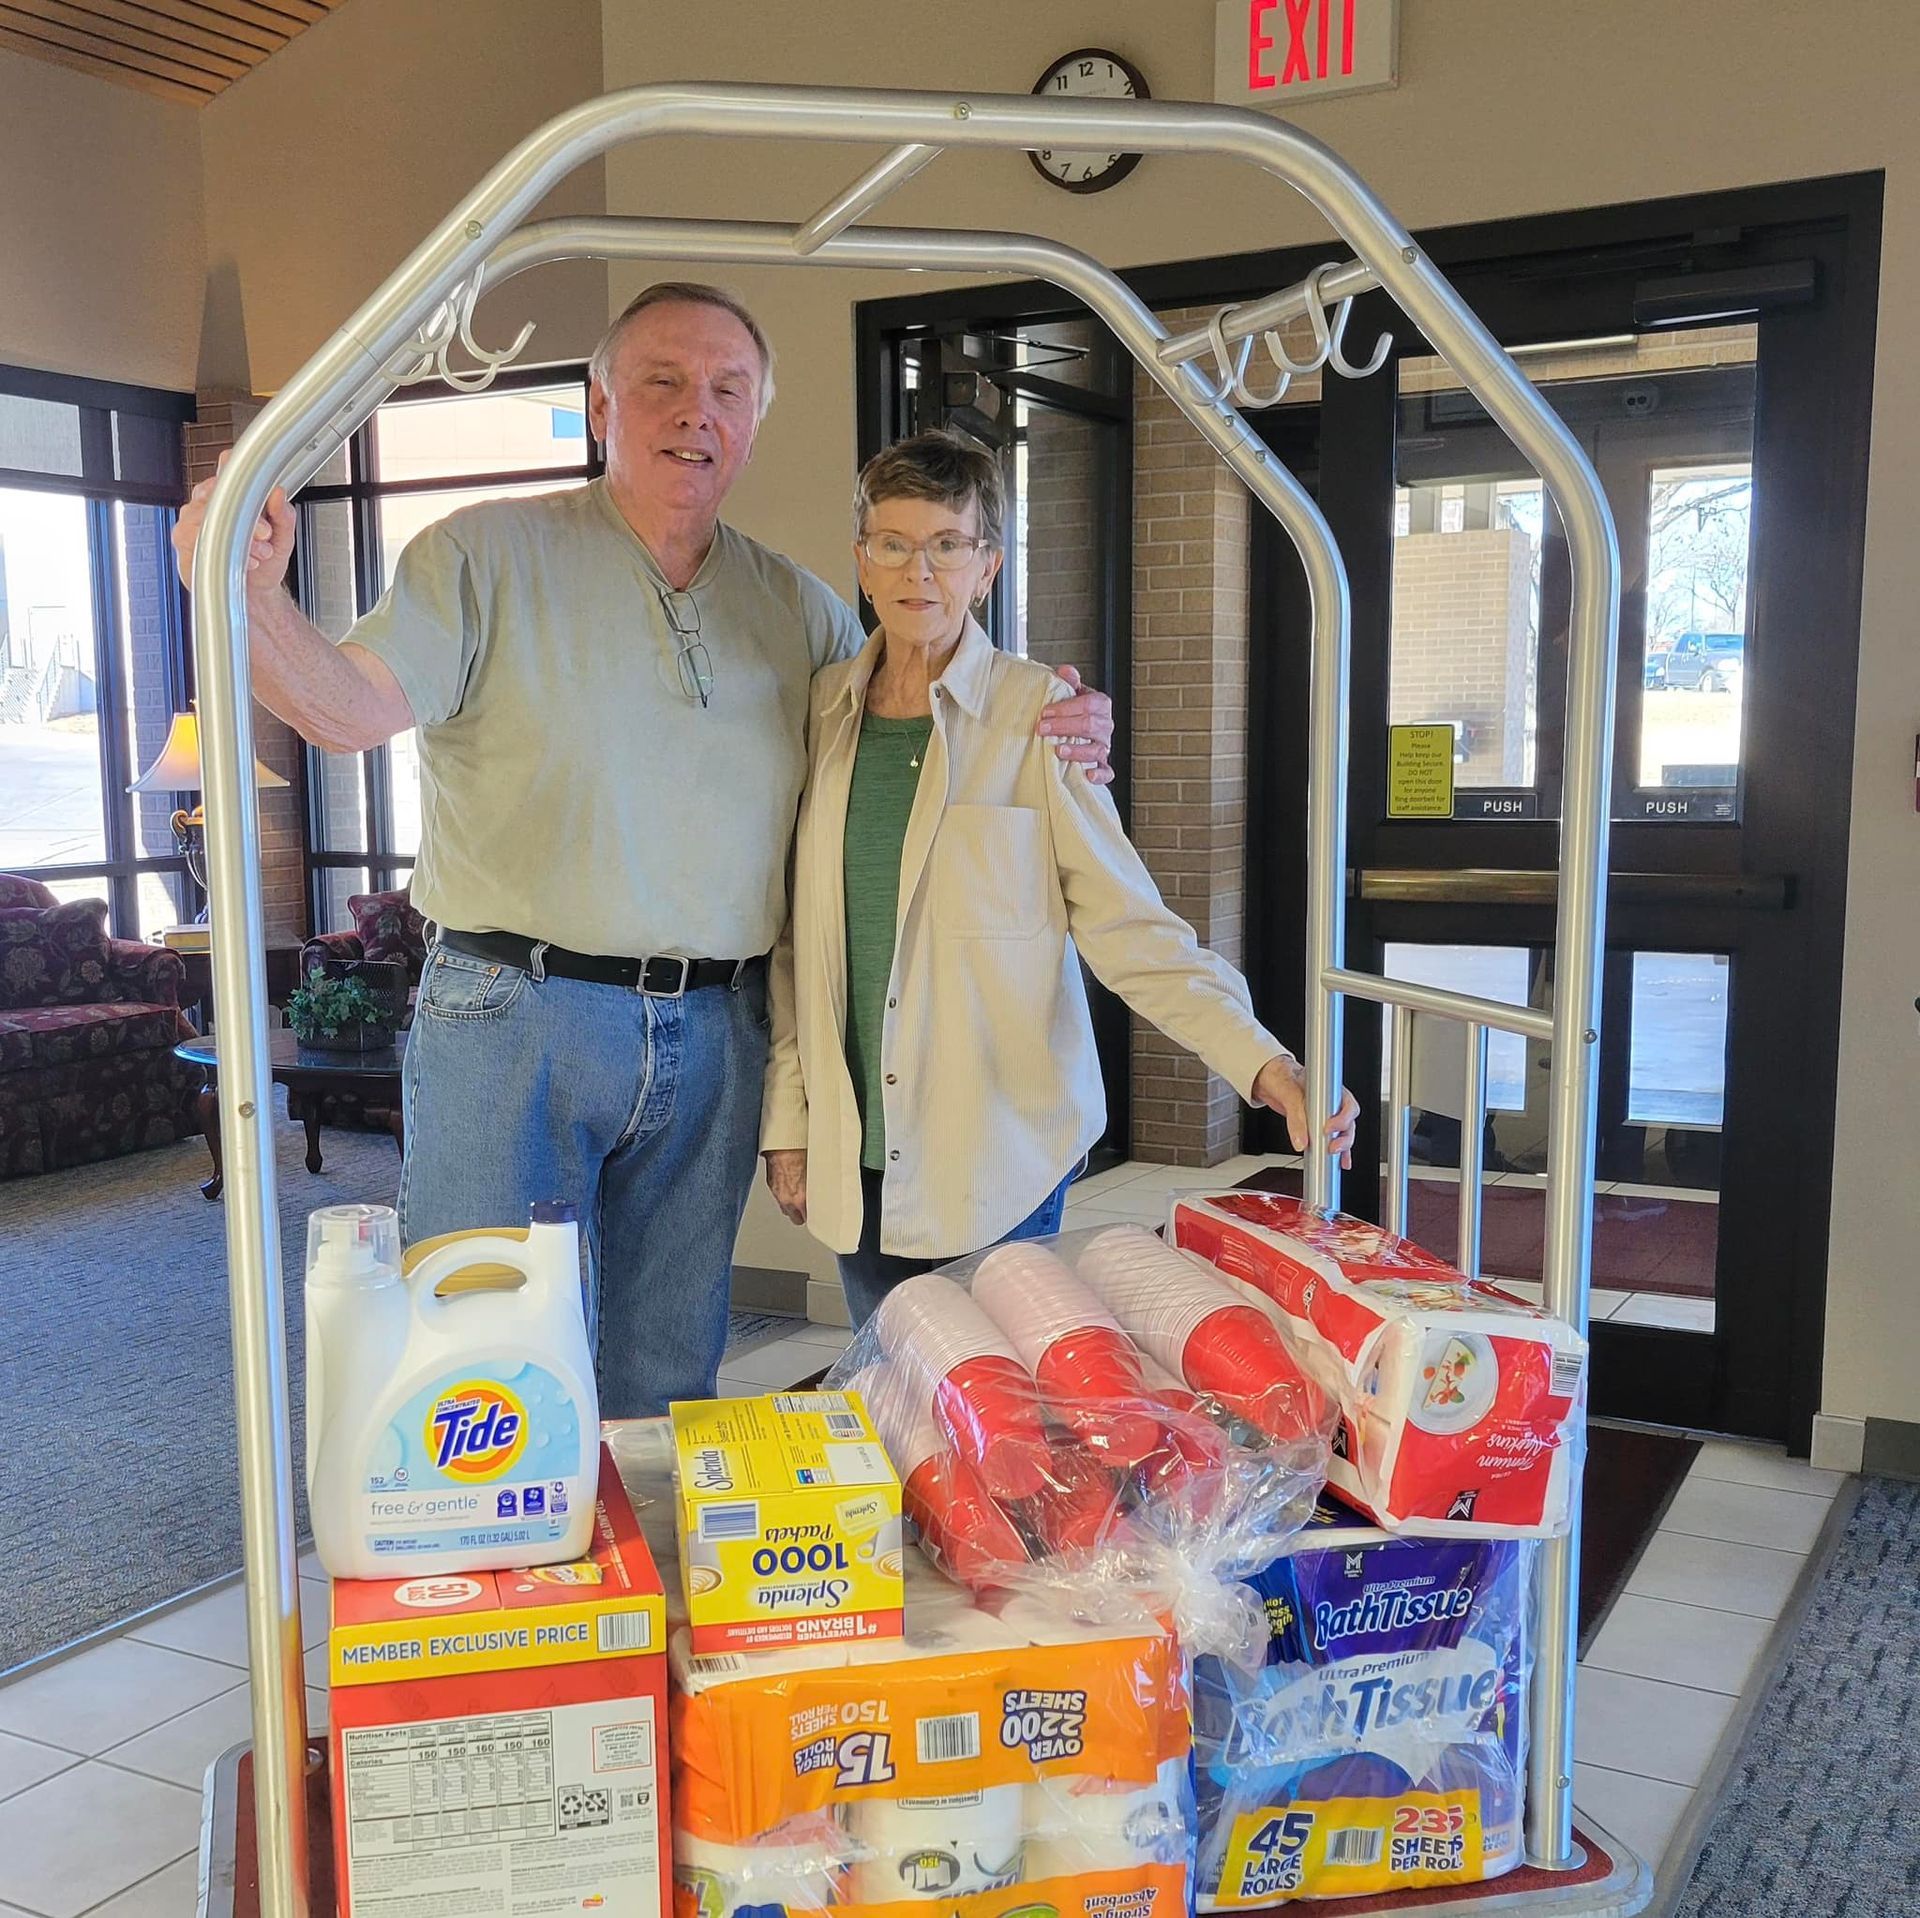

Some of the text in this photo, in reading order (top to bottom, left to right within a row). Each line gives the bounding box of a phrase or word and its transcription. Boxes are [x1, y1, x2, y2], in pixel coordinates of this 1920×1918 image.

[1248, 0, 1356, 91] EXIT
[1078, 61, 1094, 78] 12
[1107, 64, 1114, 79] 1
[1056, 75, 1068, 91] 11
[1123, 80, 1134, 96] 2
[1042, 149, 1052, 161] 8
[1107, 153, 1117, 170] 5
[1060, 162, 1072, 178] 7
[1082, 166, 1093, 180] 6
[1483, 800, 1523, 813] PUSH
[1646, 801, 1688, 814] PUSH
[432, 1401, 521, 1469] Tide
[693, 1450, 734, 1491] Splenda
[371, 1495, 478, 1516] free & gentle
[765, 1523, 834, 1544] Packets
[752, 1542, 849, 1577] 1000
[758, 1579, 849, 1609] Splenda
[1363, 1576, 1436, 1593] Ultra Premium
[796, 1616, 855, 1632] BRAND
[797, 1628, 854, 1641] SWEETENER
[856, 1615, 878, 1636] #1
[342, 1623, 589, 1666] MEMBER EXCLUSIVE PRICE
[1318, 1651, 1430, 1682] Ultra Premium
[840, 1699, 890, 1725] 150
[1004, 1690, 1085, 1713] SHEETS
[788, 1703, 839, 1726] PER ROLL
[790, 1713, 838, 1741] SHEETS
[1002, 1711, 1084, 1747] 2200
[794, 1738, 835, 1765] ROLLS
[834, 1732, 894, 1787] 15
[1029, 1738, 1081, 1761] OVER
[796, 1751, 834, 1776] MEGA
[1393, 1806, 1464, 1834] 235
[1247, 1812, 1315, 1857] 45
[919, 1856, 940, 1869] 150
[1244, 1852, 1303, 1878] LARGE
[1391, 1855, 1464, 1871] PER ROL
[1239, 1872, 1297, 1897] ROLLS
[1085, 1889, 1157, 1910] Absorbent
